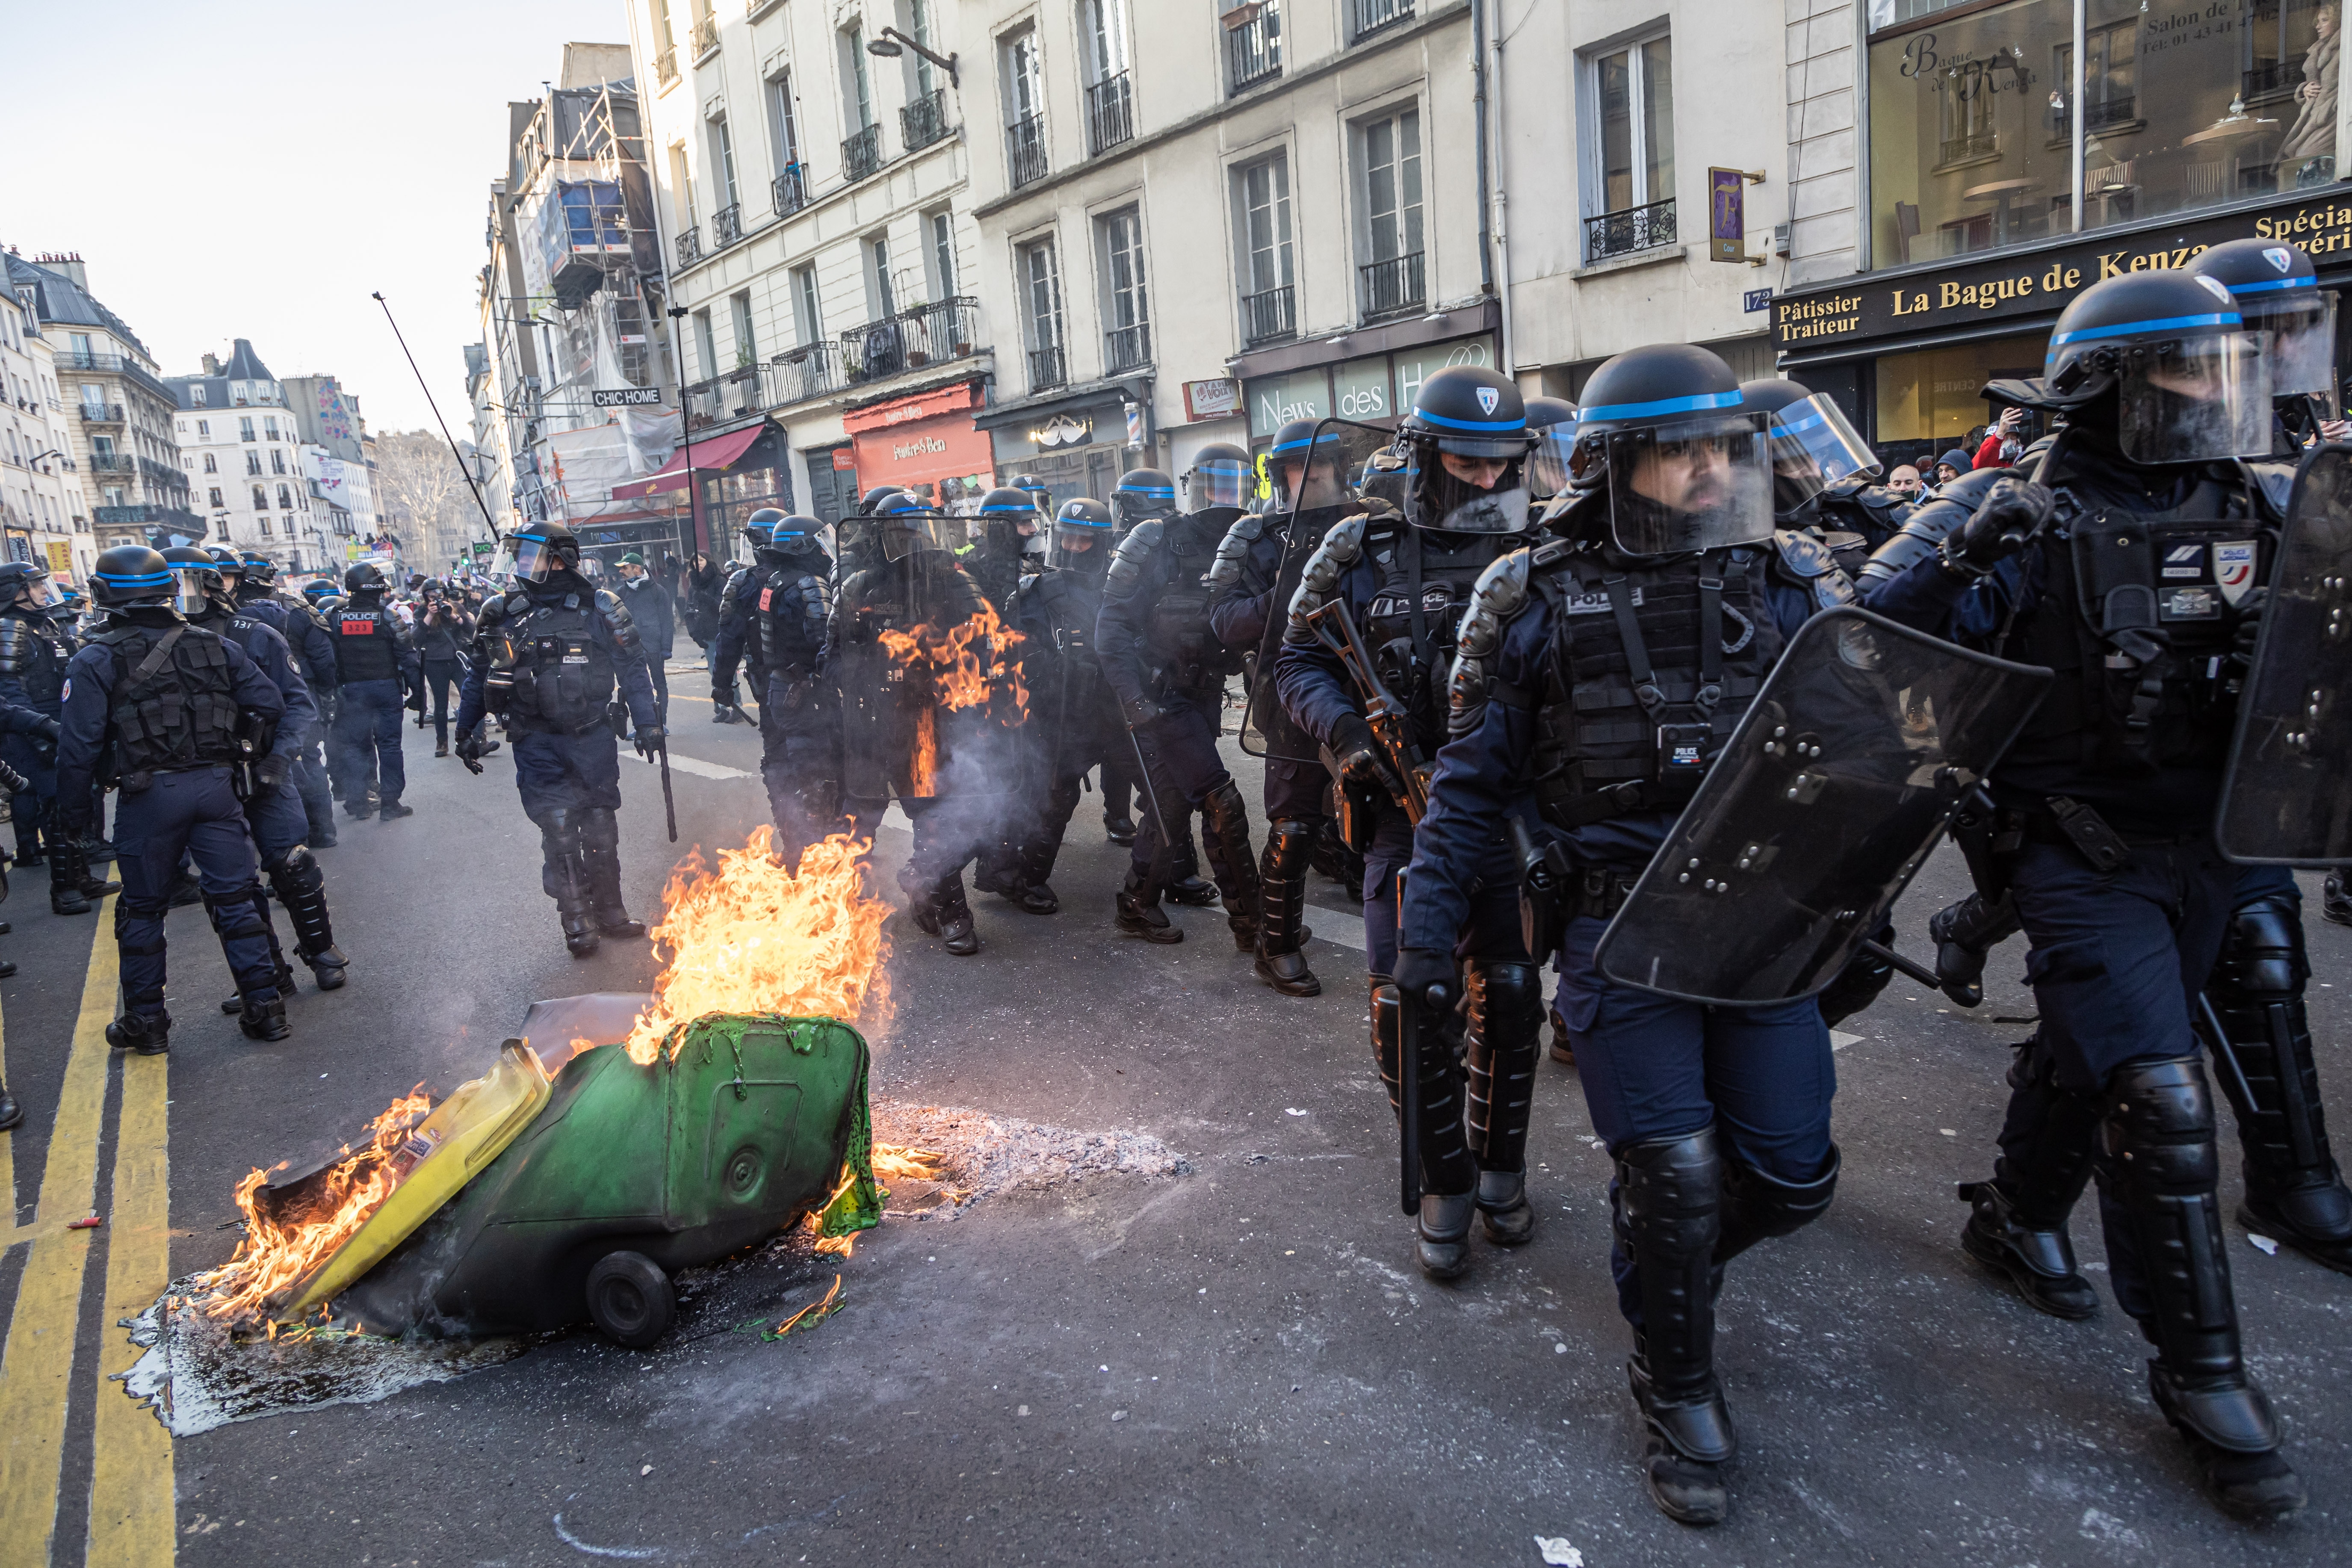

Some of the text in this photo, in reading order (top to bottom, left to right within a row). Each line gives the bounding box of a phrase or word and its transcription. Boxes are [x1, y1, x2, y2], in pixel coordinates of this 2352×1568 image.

[2148, 12, 2199, 35] Salon
[2206, 2, 2228, 18] de
[2173, 33, 2187, 46] 01
[2217, 21, 2231, 33] 41
[1900, 33, 1973, 77] Bague
[1723, 243, 1734, 253] Cour
[1892, 290, 1930, 316] La
[1938, 276, 2033, 309] Bague
[2043, 264, 2080, 292] de
[1779, 296, 1862, 323] Pâtissier
[1779, 316, 1860, 342] Traiteur
[595, 390, 659, 405] CHIC HOME
[1207, 387, 1228, 399] VOIX
[1261, 390, 1315, 430] News
[1341, 386, 1383, 416] des
[233, 620, 251, 629] 131
[341, 613, 378, 621] POLICE
[1675, 747, 1697, 755] POLICE
